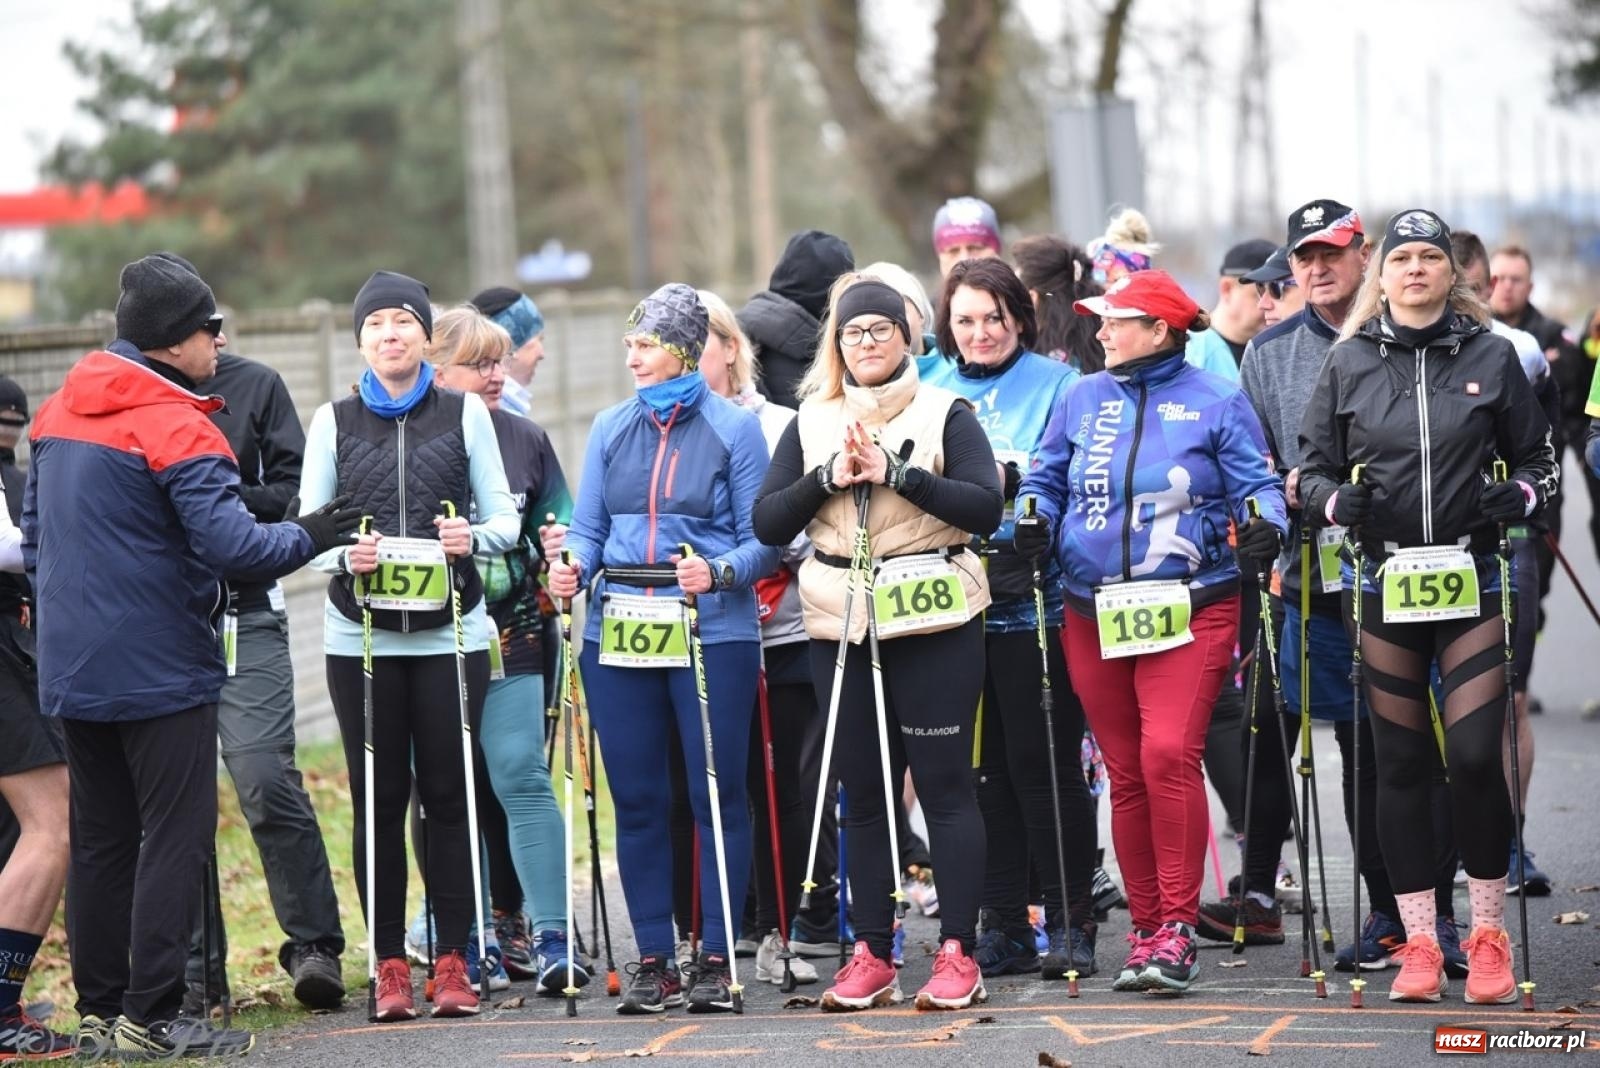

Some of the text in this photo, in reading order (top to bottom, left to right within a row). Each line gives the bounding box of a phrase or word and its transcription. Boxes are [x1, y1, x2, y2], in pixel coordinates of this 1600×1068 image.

[1084, 399, 1124, 532] RUNNERS
[369, 563, 435, 597] 157
[887, 578, 954, 619] 168
[1397, 572, 1464, 609] 159
[613, 621, 674, 654] 167
[1112, 606, 1176, 643] 181
[914, 725, 961, 736] GLAMOUR
